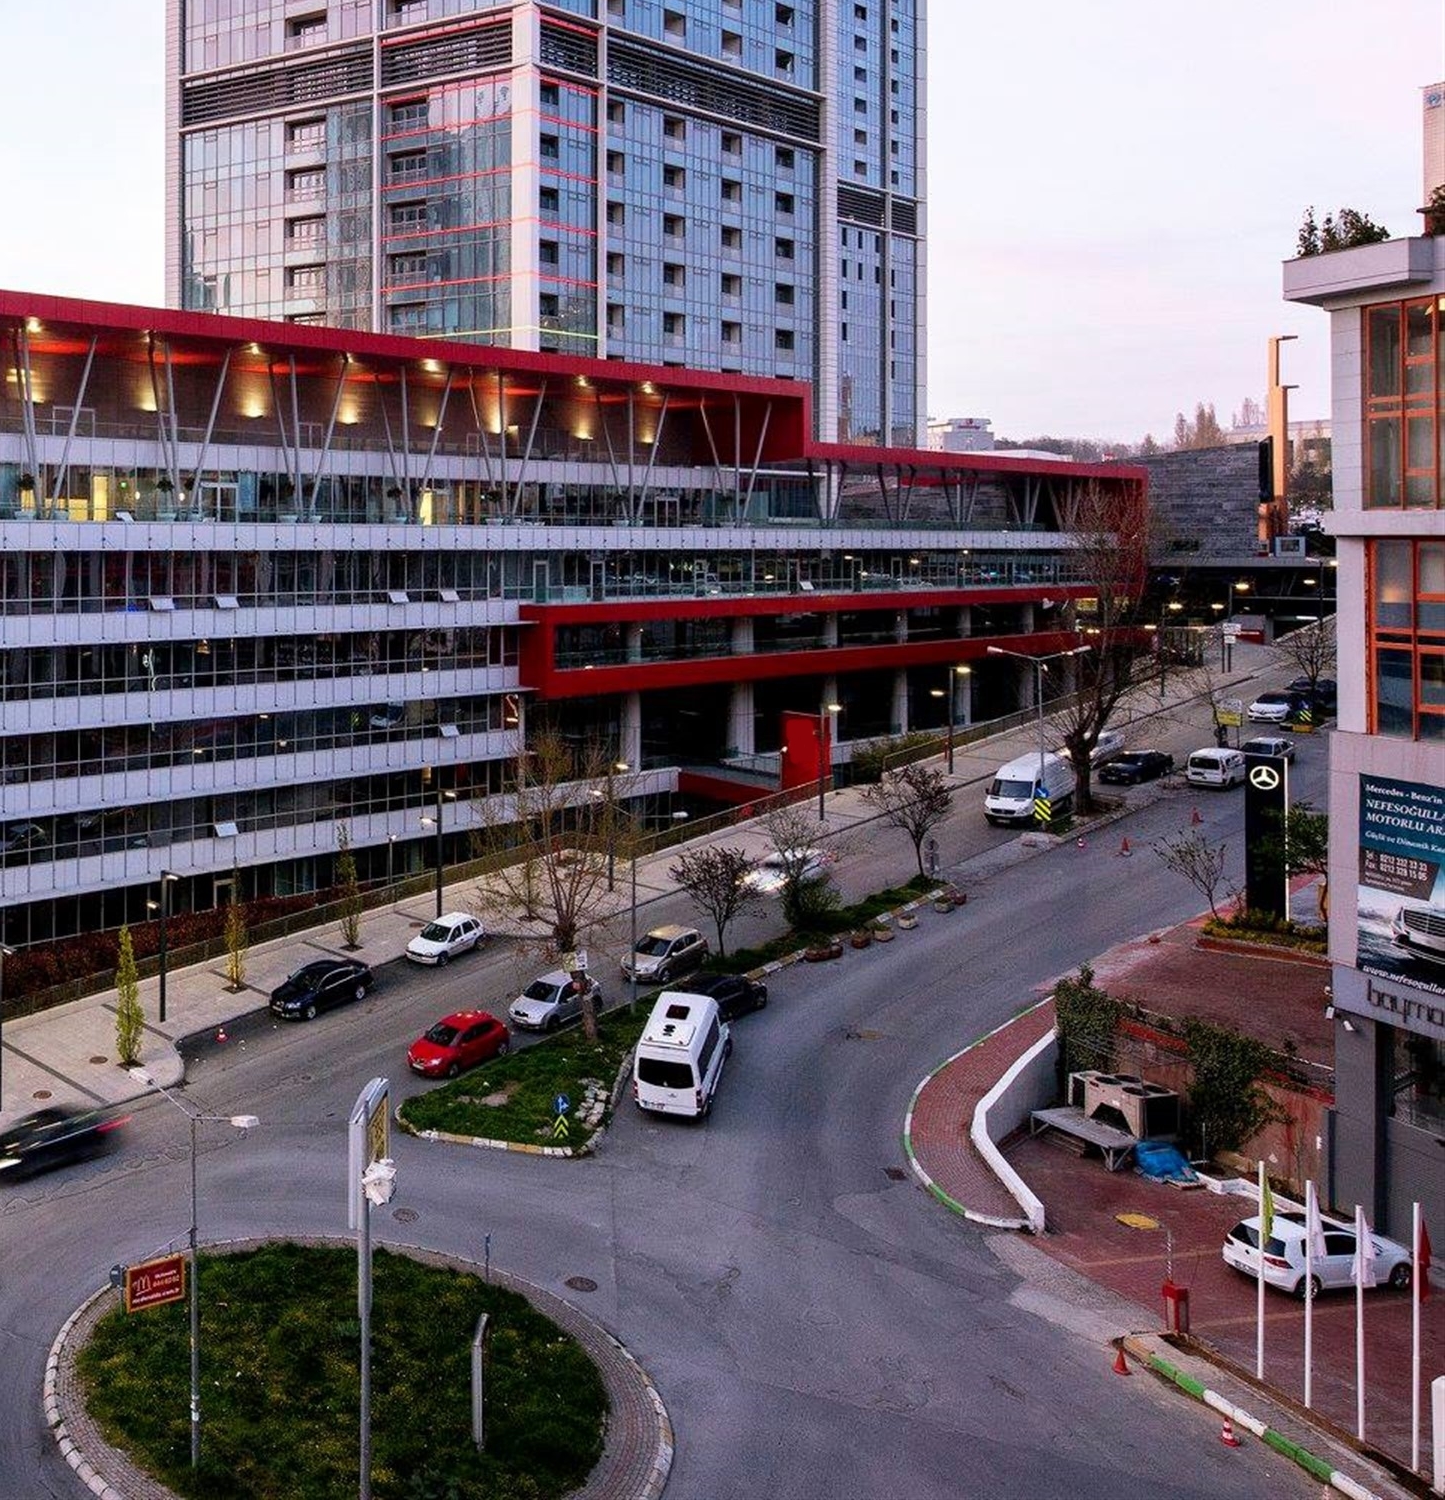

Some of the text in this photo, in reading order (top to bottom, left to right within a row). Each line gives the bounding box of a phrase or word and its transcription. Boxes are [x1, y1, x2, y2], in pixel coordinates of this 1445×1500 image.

[1365, 784, 1404, 798] Mercedes
[1365, 812, 1445, 836] MOTORLU AR
